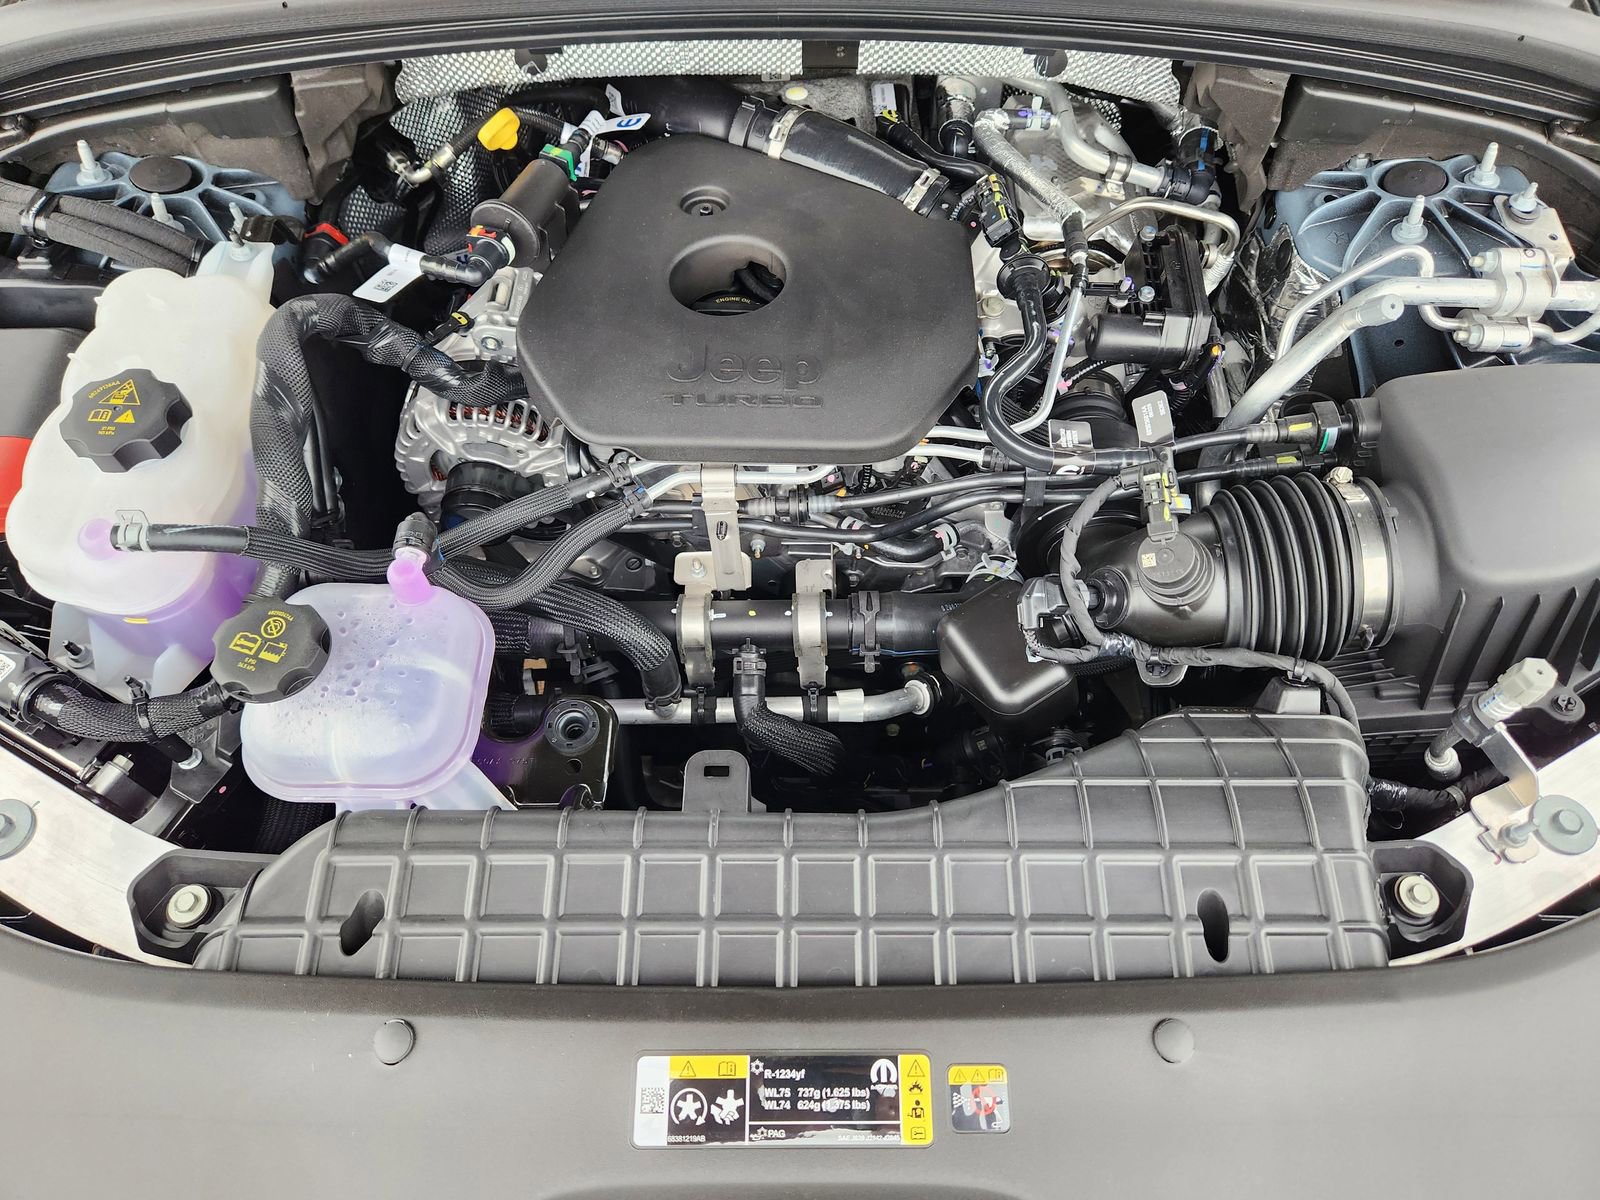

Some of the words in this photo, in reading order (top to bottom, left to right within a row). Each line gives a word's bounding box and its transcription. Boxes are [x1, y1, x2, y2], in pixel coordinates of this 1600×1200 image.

[715, 296, 741, 305] ENGINE
[741, 297, 752, 305] OIL
[666, 334, 823, 393] Jeep
[663, 392, 826, 409] TURBO
[764, 1068, 806, 1081] R-1234yf
[764, 1087, 791, 1098] WL75
[797, 1087, 821, 1099] 737g
[822, 1087, 851, 1099] (1.625
[851, 1087, 870, 1099] lbs)
[764, 1100, 791, 1110] WL74
[797, 1100, 821, 1111] 624g
[851, 1100, 870, 1111] lbs)
[768, 1129, 786, 1138] PAG
